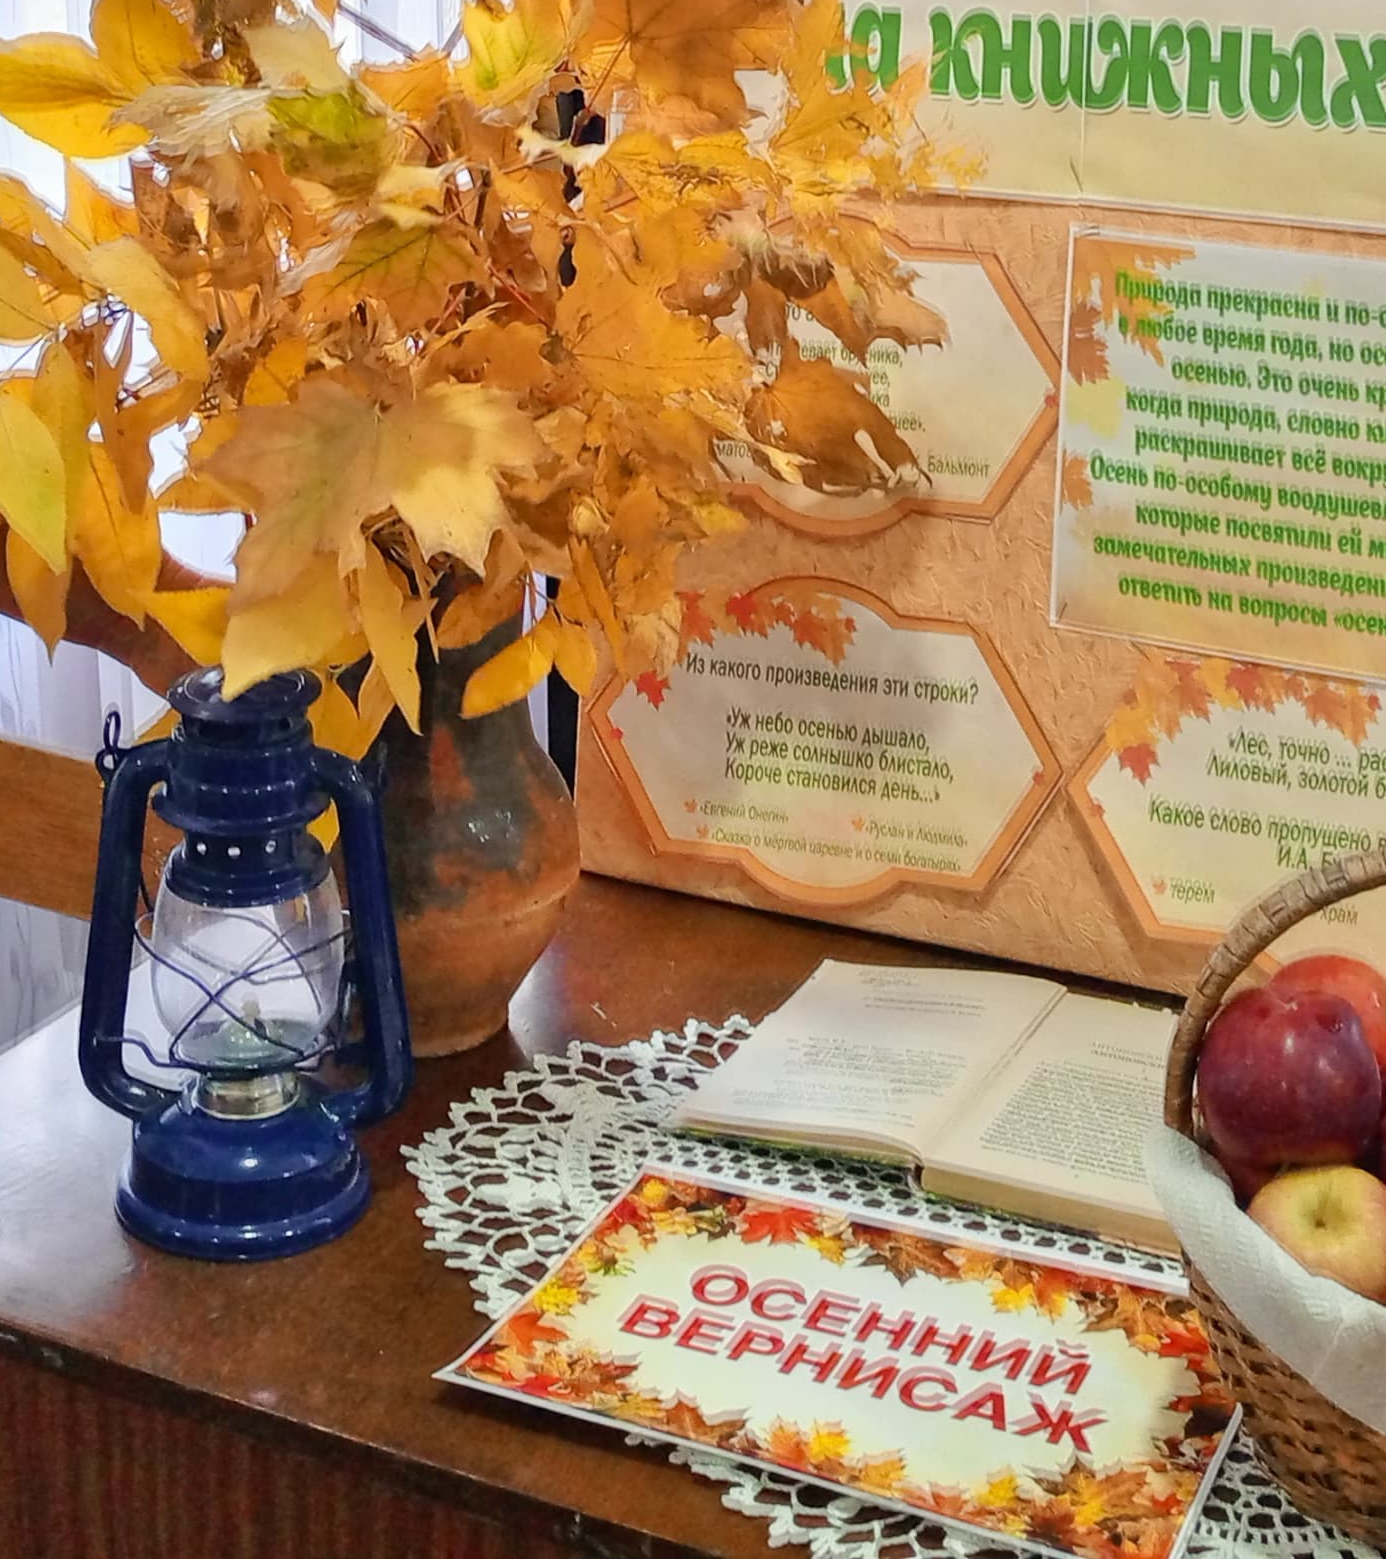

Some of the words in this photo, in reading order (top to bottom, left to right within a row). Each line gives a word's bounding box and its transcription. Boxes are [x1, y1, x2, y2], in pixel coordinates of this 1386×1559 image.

[1115, 272, 1202, 314] Природа
[1206, 288, 1321, 327] прекрасна
[1326, 301, 1338, 323] и
[1135, 311, 1198, 344] любое
[1201, 325, 1265, 359] время
[1270, 333, 1325, 363] года,
[1329, 340, 1355, 363] но
[1170, 360, 1252, 389] осенью.
[1256, 364, 1294, 394] Это
[1298, 375, 1360, 402] очень
[1125, 391, 1183, 421] когда
[1187, 398, 1282, 436] природа,
[1286, 411, 1361, 440] словно
[927, 456, 990, 477] Бальмонт
[1134, 428, 1285, 474] раскрашивает
[1290, 439, 1327, 473] всё
[1089, 453, 1148, 487] Осень
[1152, 464, 1272, 510] по-особому
[1135, 503, 1221, 541] которые
[1226, 516, 1332, 551] посвятили
[1336, 523, 1363, 556] ей
[1093, 534, 1251, 577] замечательных
[1117, 575, 1203, 608] ответить
[1207, 589, 1233, 613] на
[1237, 594, 1328, 634] вопросы
[685, 654, 705, 673] Из
[709, 659, 760, 680] какого
[765, 666, 878, 697] произведения
[883, 679, 909, 697] эти
[914, 678, 979, 707] строки?
[726, 708, 751, 729] «Уж
[755, 710, 793, 734] небо
[797, 720, 857, 742] осенью
[861, 728, 929, 754] дышало,
[1279, 740, 1330, 765] точно
[724, 760, 782, 788] Короче
[786, 769, 876, 796] становился
[725, 732, 744, 753] Уж
[748, 738, 788, 763] реже
[792, 745, 873, 769] солнышко
[878, 752, 954, 781] блистало,
[1207, 753, 1292, 790] Лиловый,
[1298, 770, 1369, 796] золотой
[1149, 800, 1205, 828] Какое
[1211, 811, 1262, 837] слово
[1268, 820, 1371, 853] пропущено
[1277, 846, 1312, 870] И.А.
[1170, 882, 1214, 904] терем
[691, 1268, 1092, 1395] ОСЕННИЙ
[619, 1298, 1107, 1453] ВЕРНИСАЖ
